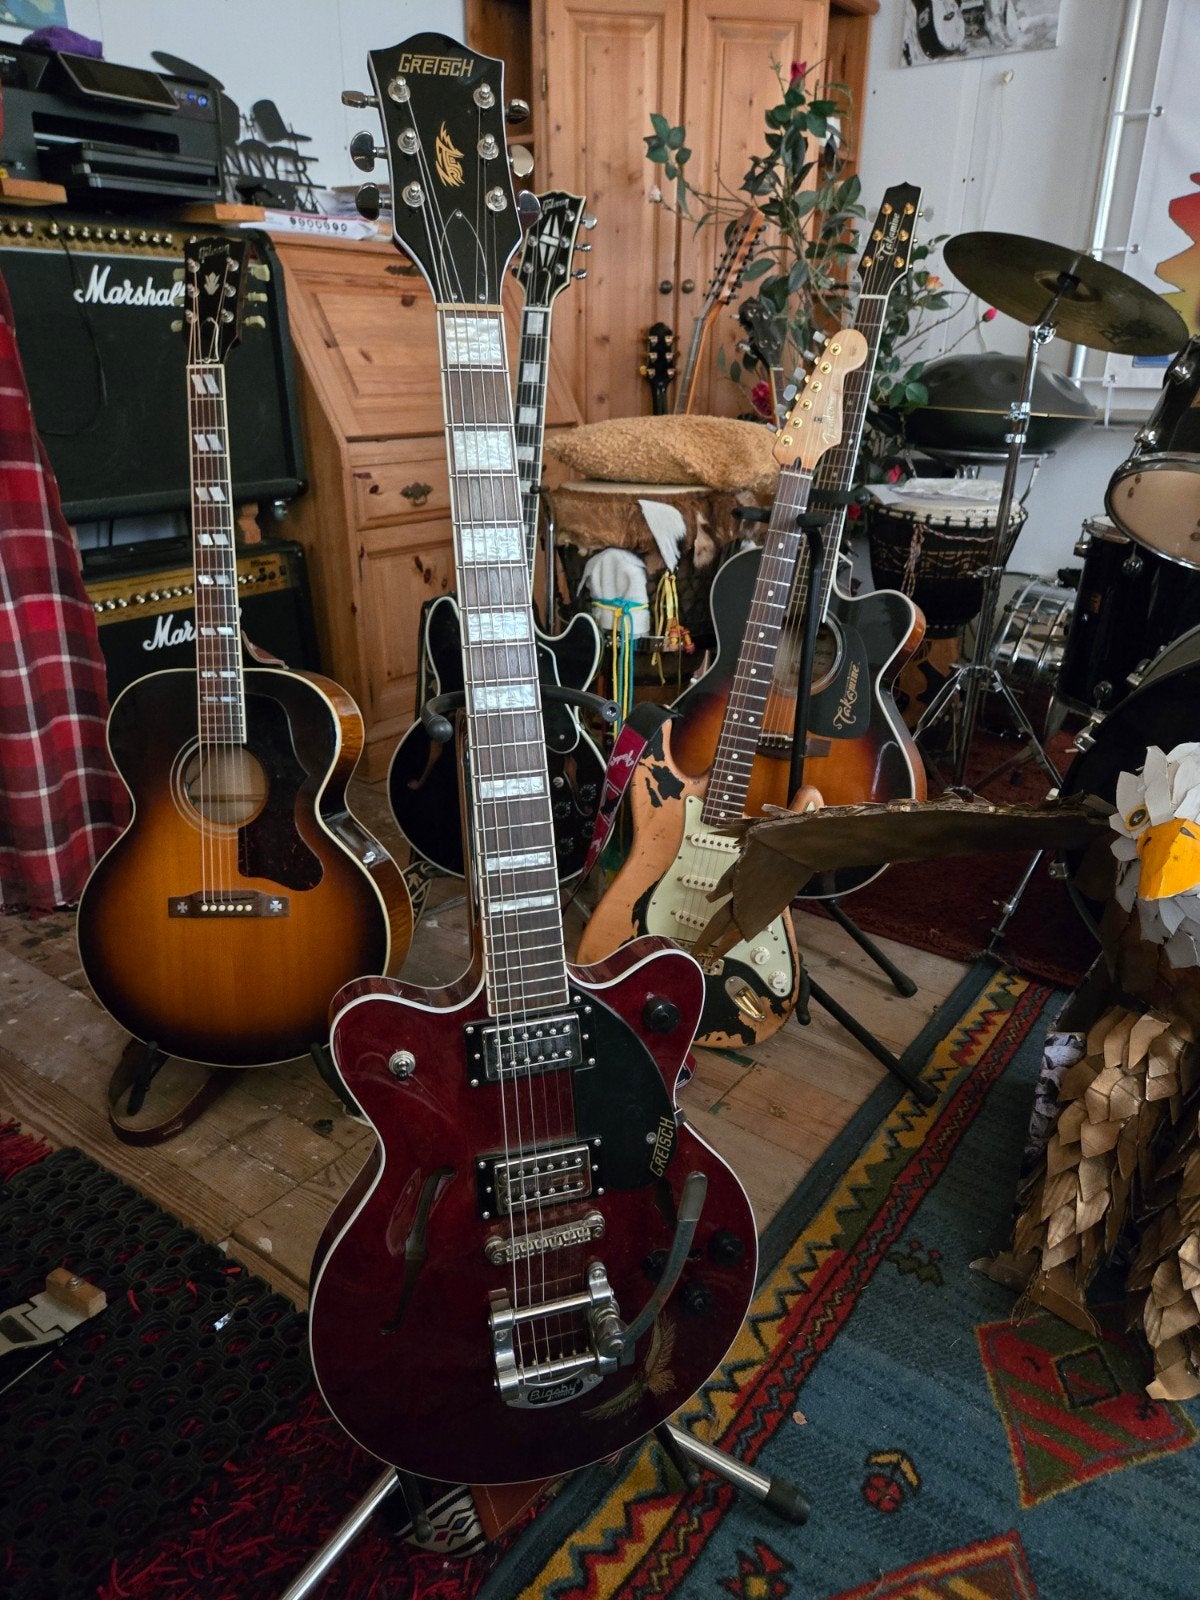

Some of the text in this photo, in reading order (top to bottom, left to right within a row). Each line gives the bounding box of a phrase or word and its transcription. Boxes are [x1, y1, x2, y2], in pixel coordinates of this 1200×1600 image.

[398, 53, 475, 78] GRETSCH
[832, 661, 860, 730] Takamine
[650, 1116, 675, 1177] GRETSCH
[530, 1382, 577, 1401] Bigsby
